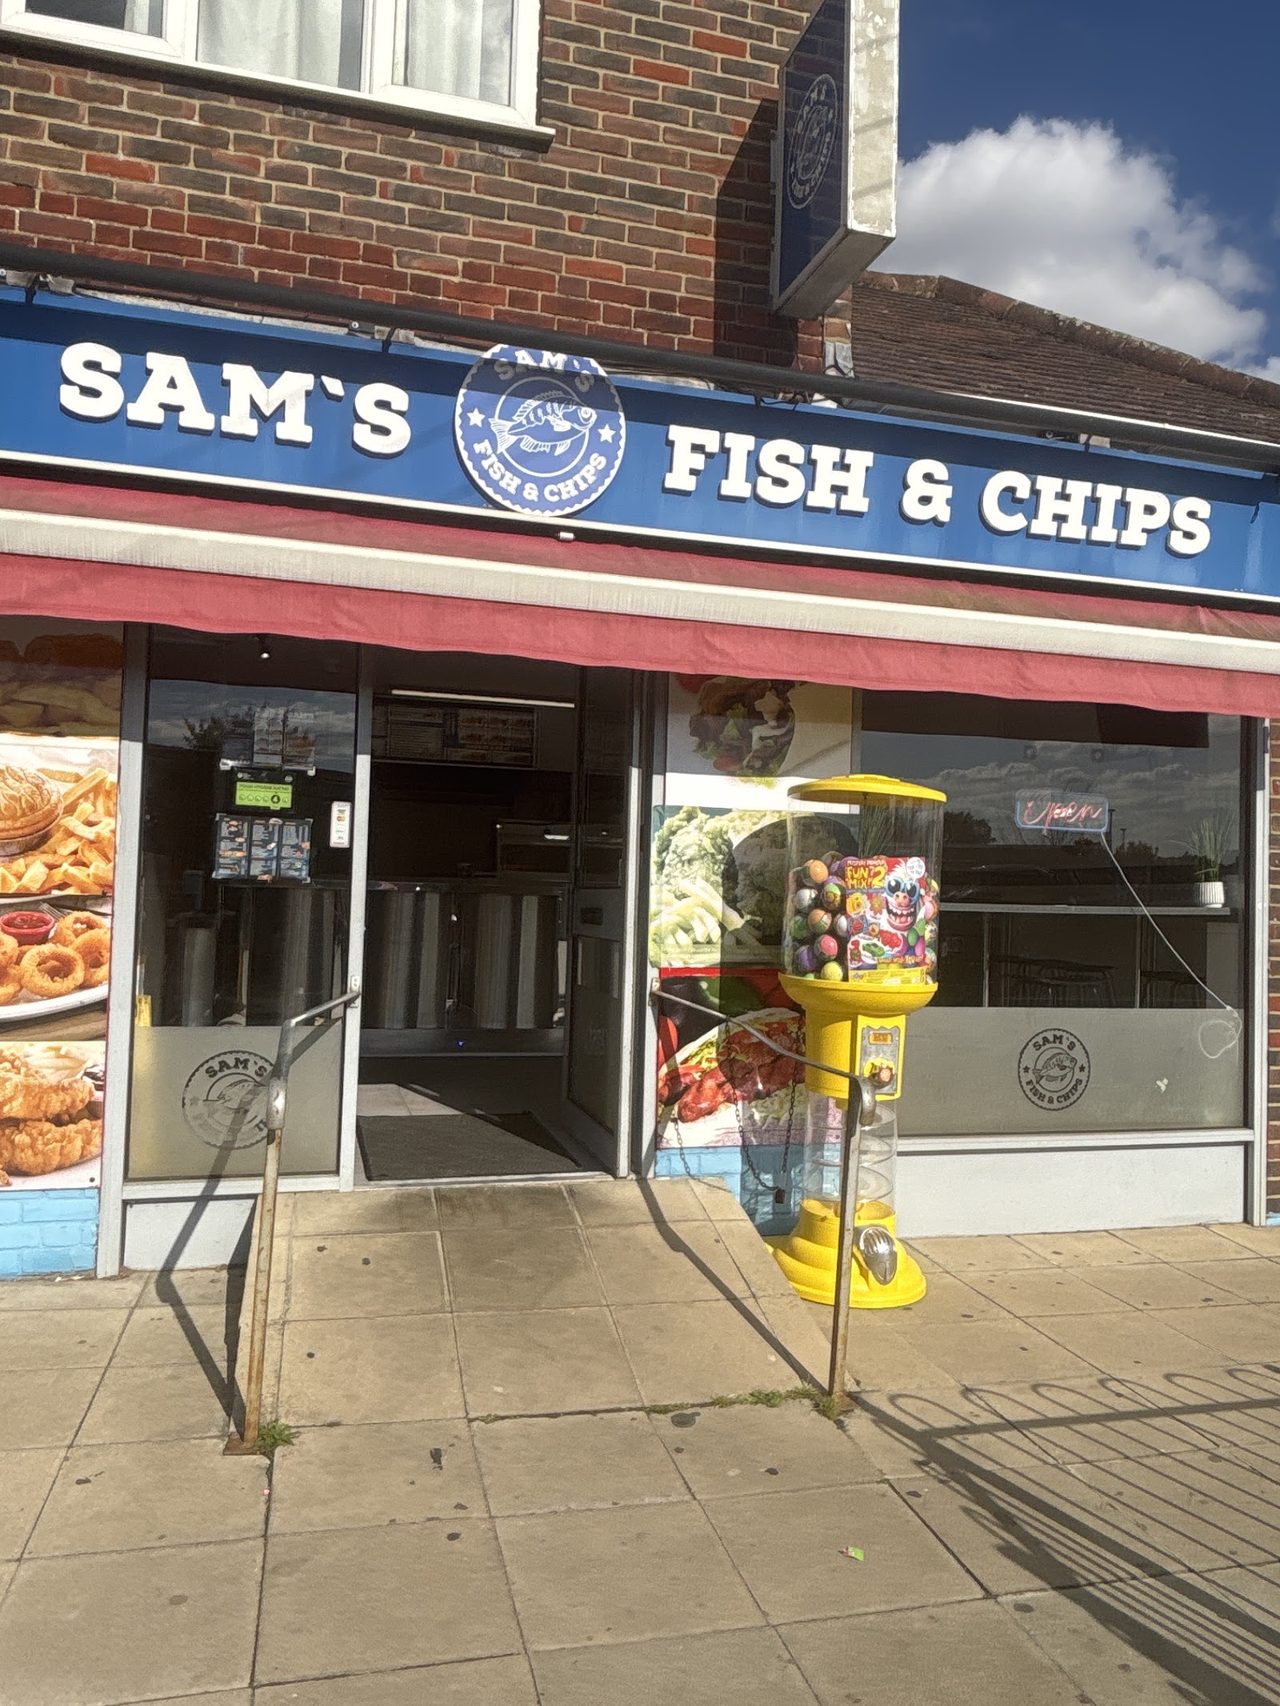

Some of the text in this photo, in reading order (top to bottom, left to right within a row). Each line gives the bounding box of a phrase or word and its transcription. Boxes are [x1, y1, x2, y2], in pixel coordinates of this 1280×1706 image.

[494, 349, 595, 393] SAM'S
[60, 342, 411, 455] SAM'S
[473, 439, 607, 502] FISH & CHIPS
[664, 424, 1212, 556] FISH & CHIPS
[847, 866, 885, 888] FUN 2
[1032, 1034, 1077, 1051] SAM'S
[205, 1057, 268, 1078] SAM'S
[1026, 1079, 1046, 1102] FISH
[1056, 1078, 1083, 1104] CHIPS
